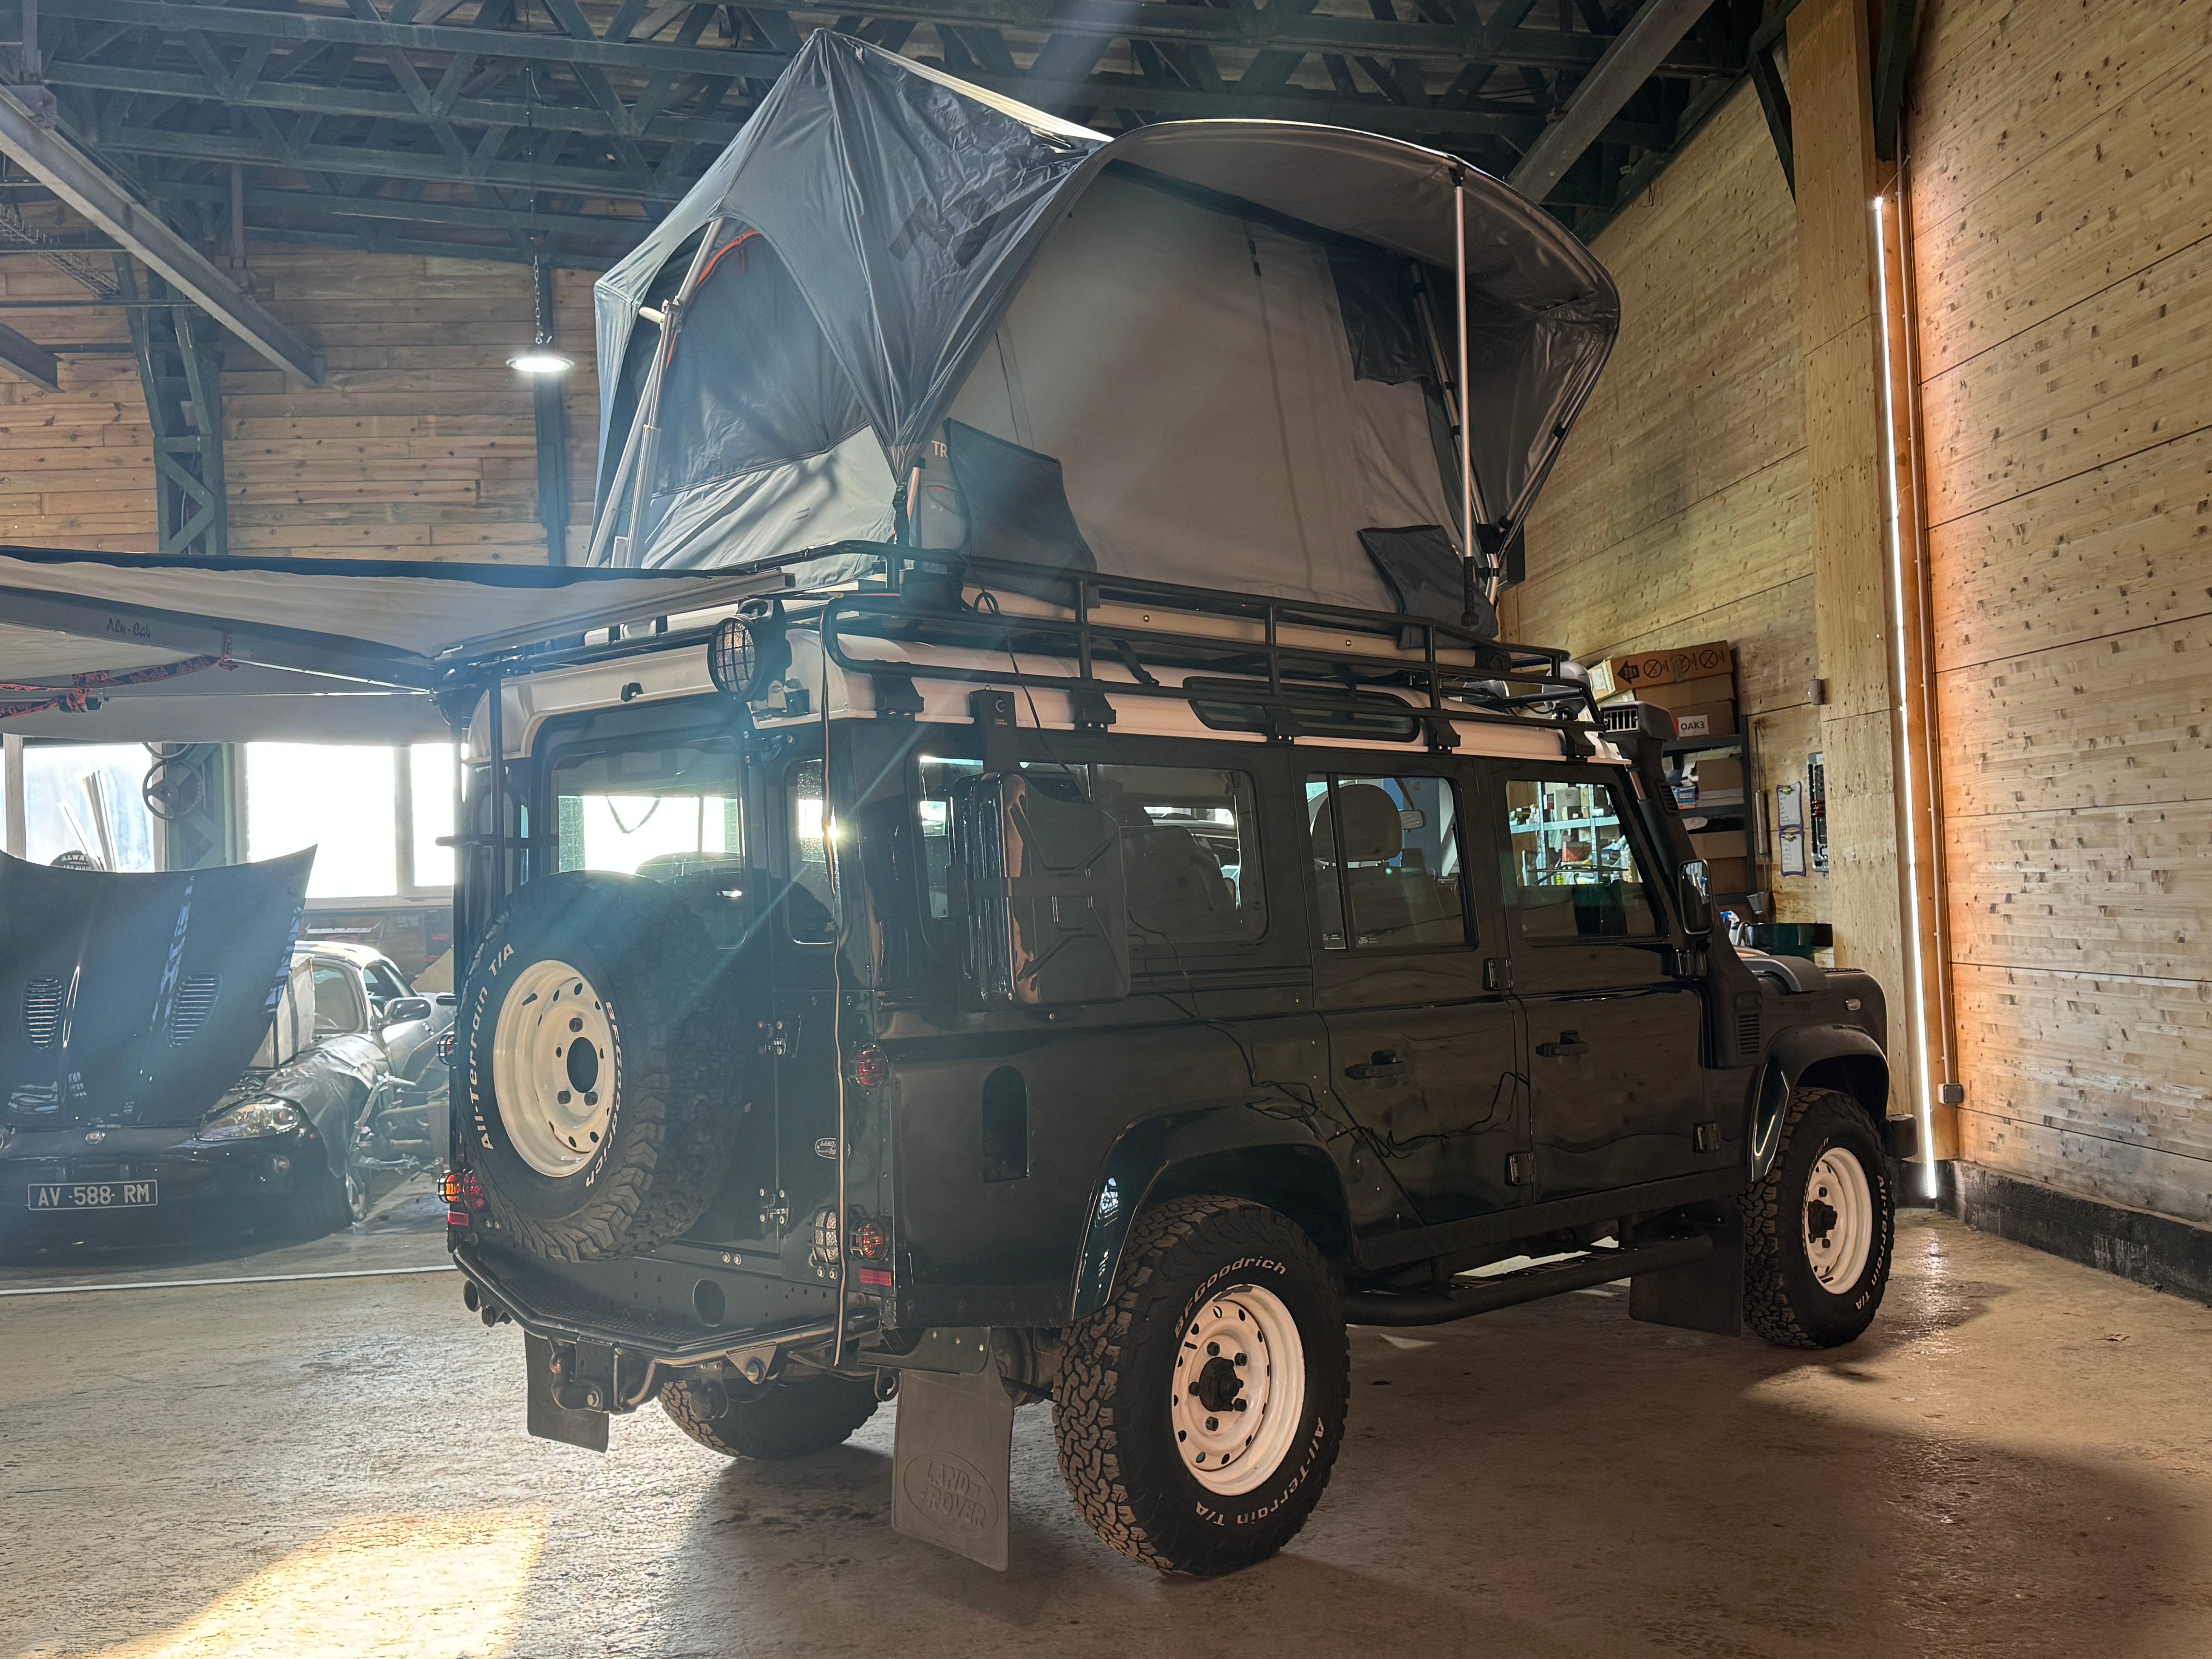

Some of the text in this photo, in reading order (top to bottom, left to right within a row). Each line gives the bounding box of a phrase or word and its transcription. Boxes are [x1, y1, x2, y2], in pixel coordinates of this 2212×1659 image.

[1681, 721, 1705, 731] OAK3
[470, 986, 494, 1149] All-Terrain
[1175, 1256, 1286, 1338] BFGoodrich
[1237, 1417, 1324, 1524] All-Terrain
